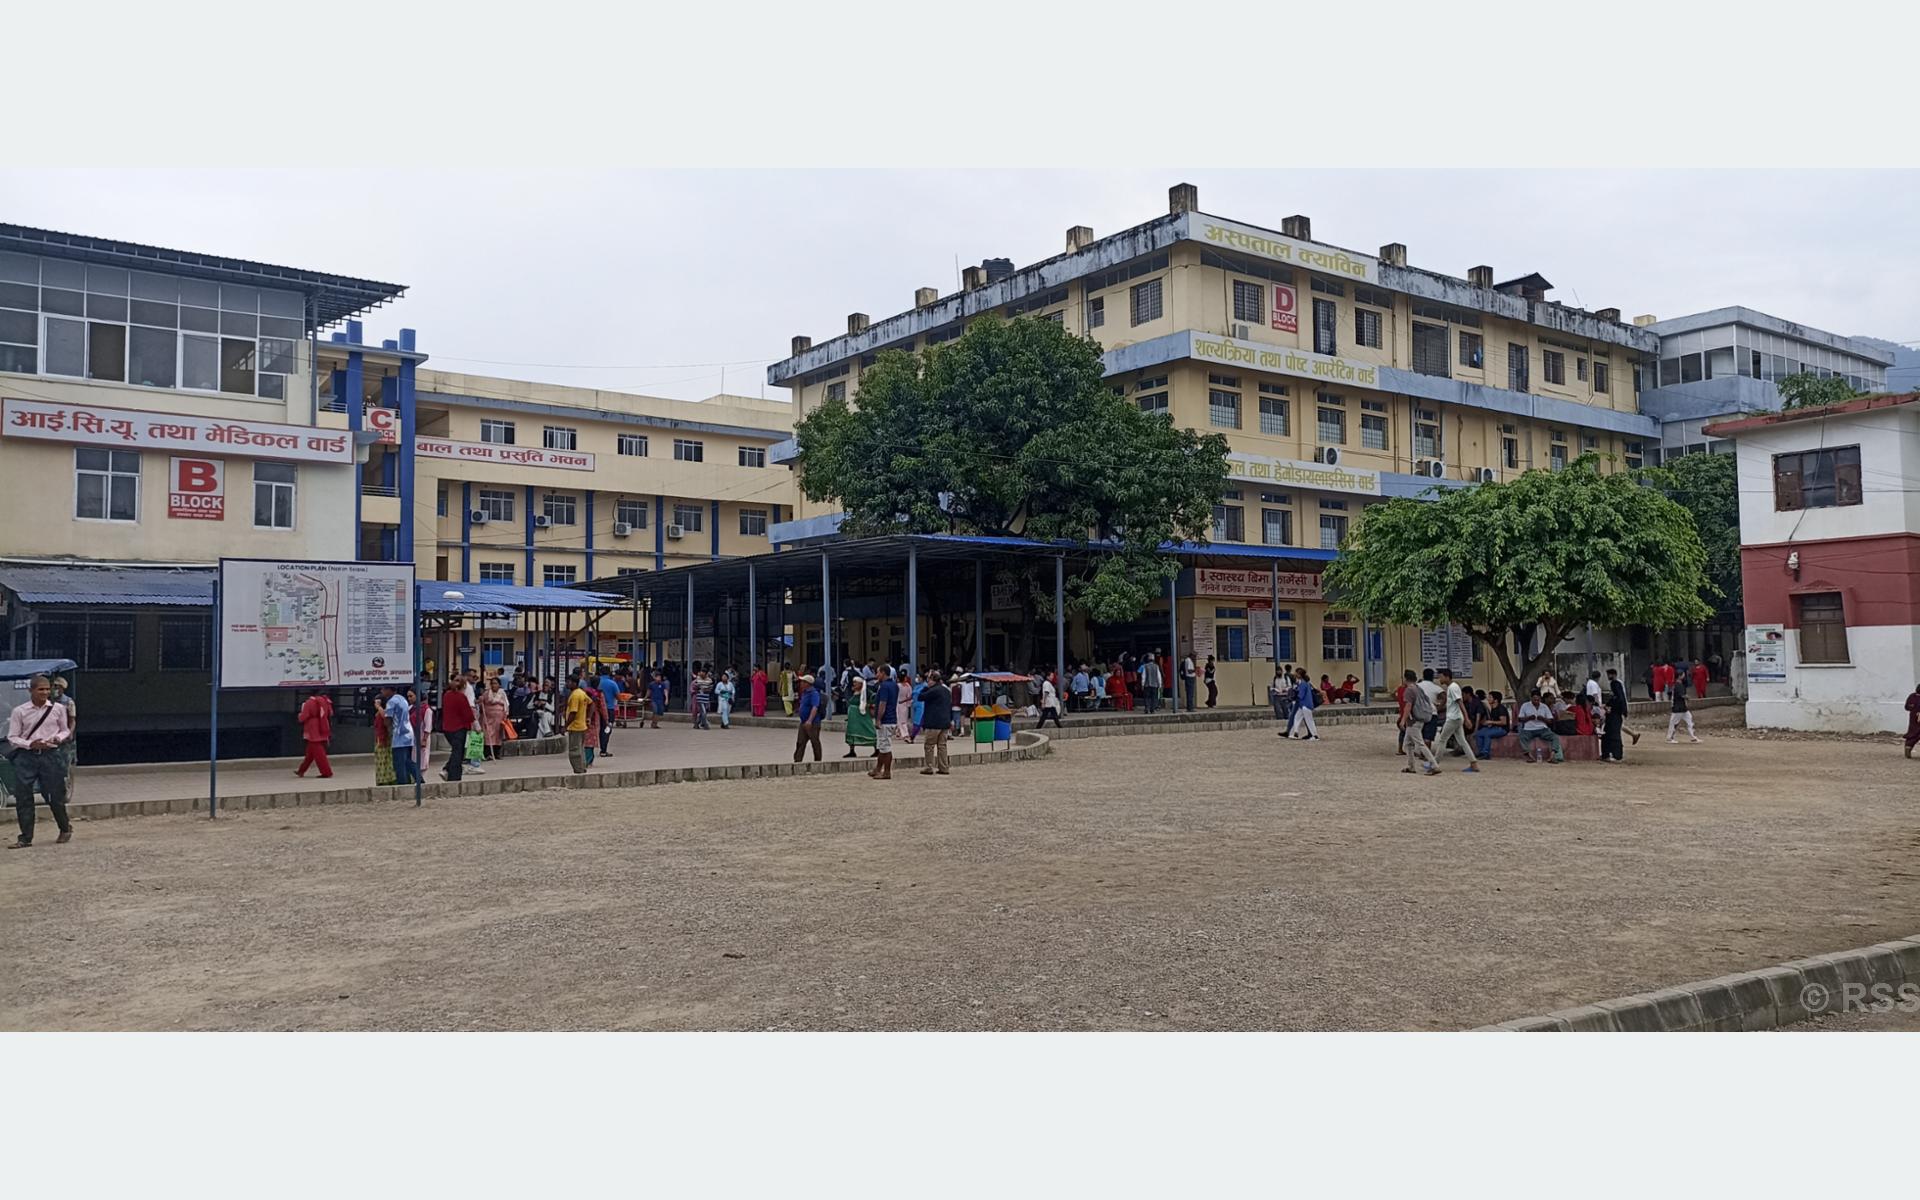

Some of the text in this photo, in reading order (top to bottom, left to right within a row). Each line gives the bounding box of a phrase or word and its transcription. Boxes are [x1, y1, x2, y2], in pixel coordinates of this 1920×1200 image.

[1203, 224, 1292, 259] अस्पताल
[1276, 287, 1294, 312] D
[1272, 312, 1297, 325] BLOCK
[1194, 339, 1256, 364] शल्यक्रिया
[1259, 350, 1281, 368] तथा
[1358, 367, 1375, 384] वार्ड
[371, 410, 392, 429] C
[148, 423, 197, 440] तथा
[205, 424, 299, 449] मेडिकल
[307, 436, 347, 453] वार्ड
[459, 446, 493, 457] तथा
[550, 454, 587, 466] भवन
[179, 460, 218, 492] B
[1249, 462, 1270, 478] तथा
[1359, 473, 1375, 490] वार्ड
[170, 495, 223, 509] BLOCK
